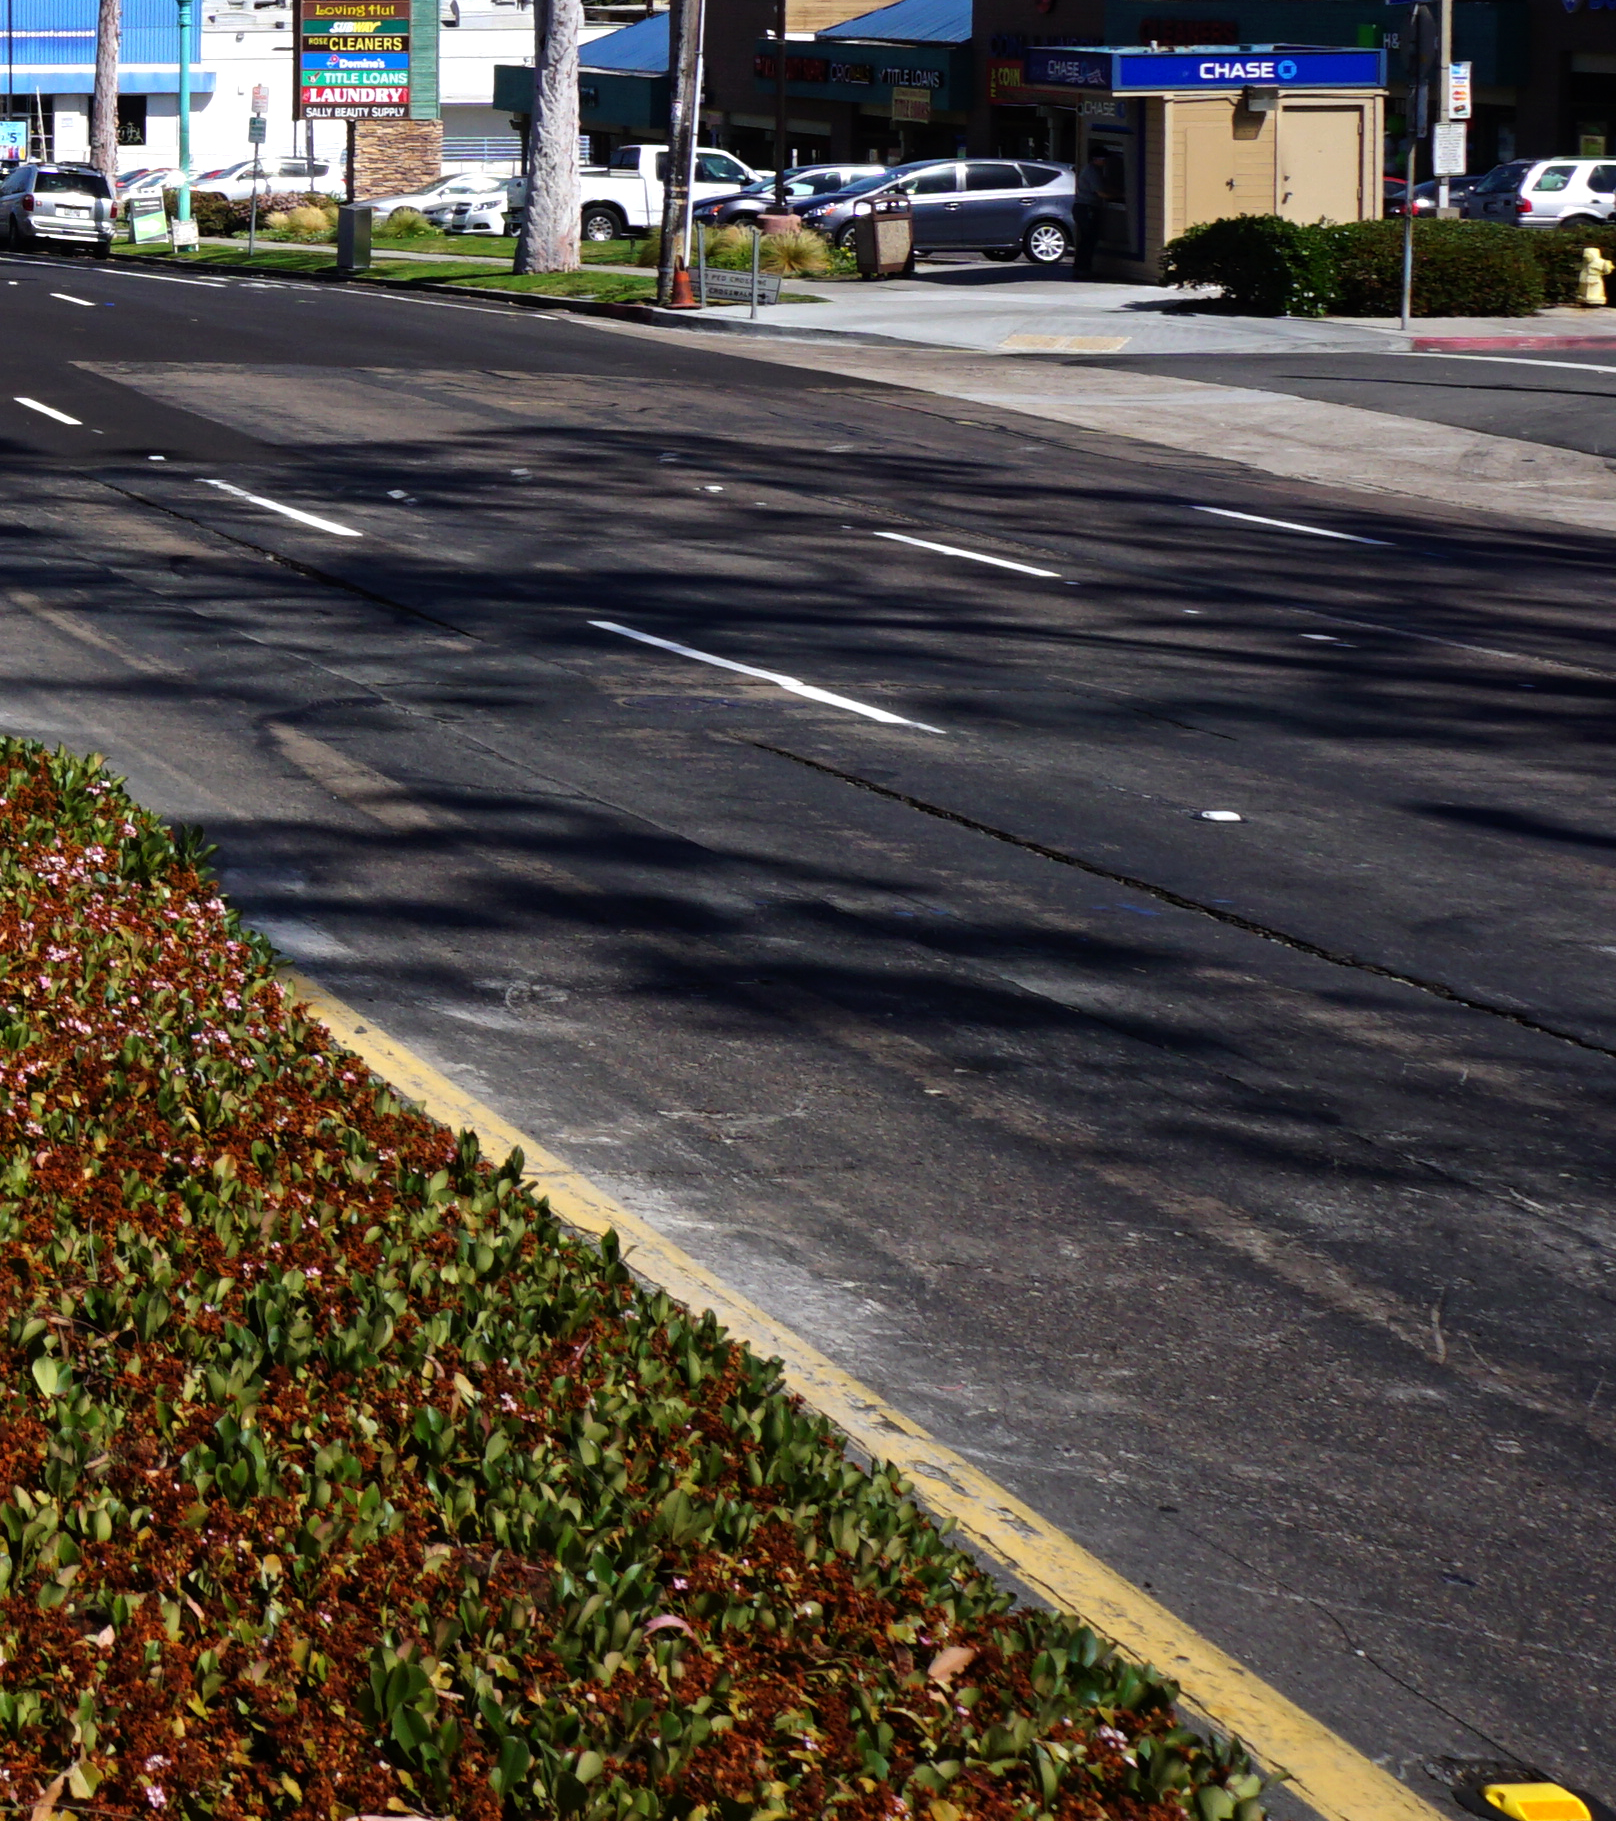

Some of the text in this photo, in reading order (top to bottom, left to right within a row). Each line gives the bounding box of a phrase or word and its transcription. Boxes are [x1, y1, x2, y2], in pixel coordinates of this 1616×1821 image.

[315, 4, 395, 17] Loving Hut
[329, 21, 382, 33] SUBWAY
[329, 37, 402, 51] CLEANERS
[339, 58, 385, 68] Domino's
[1199, 62, 1275, 79] CHASE
[324, 73, 408, 84] TITLE LOANS
[887, 68, 940, 88] TITLE LOANS
[309, 88, 403, 102] LAUNDRY
[306, 107, 405, 117] SALLY BEAUTY SUPPLY
[1085, 100, 1116, 117] CHASE
